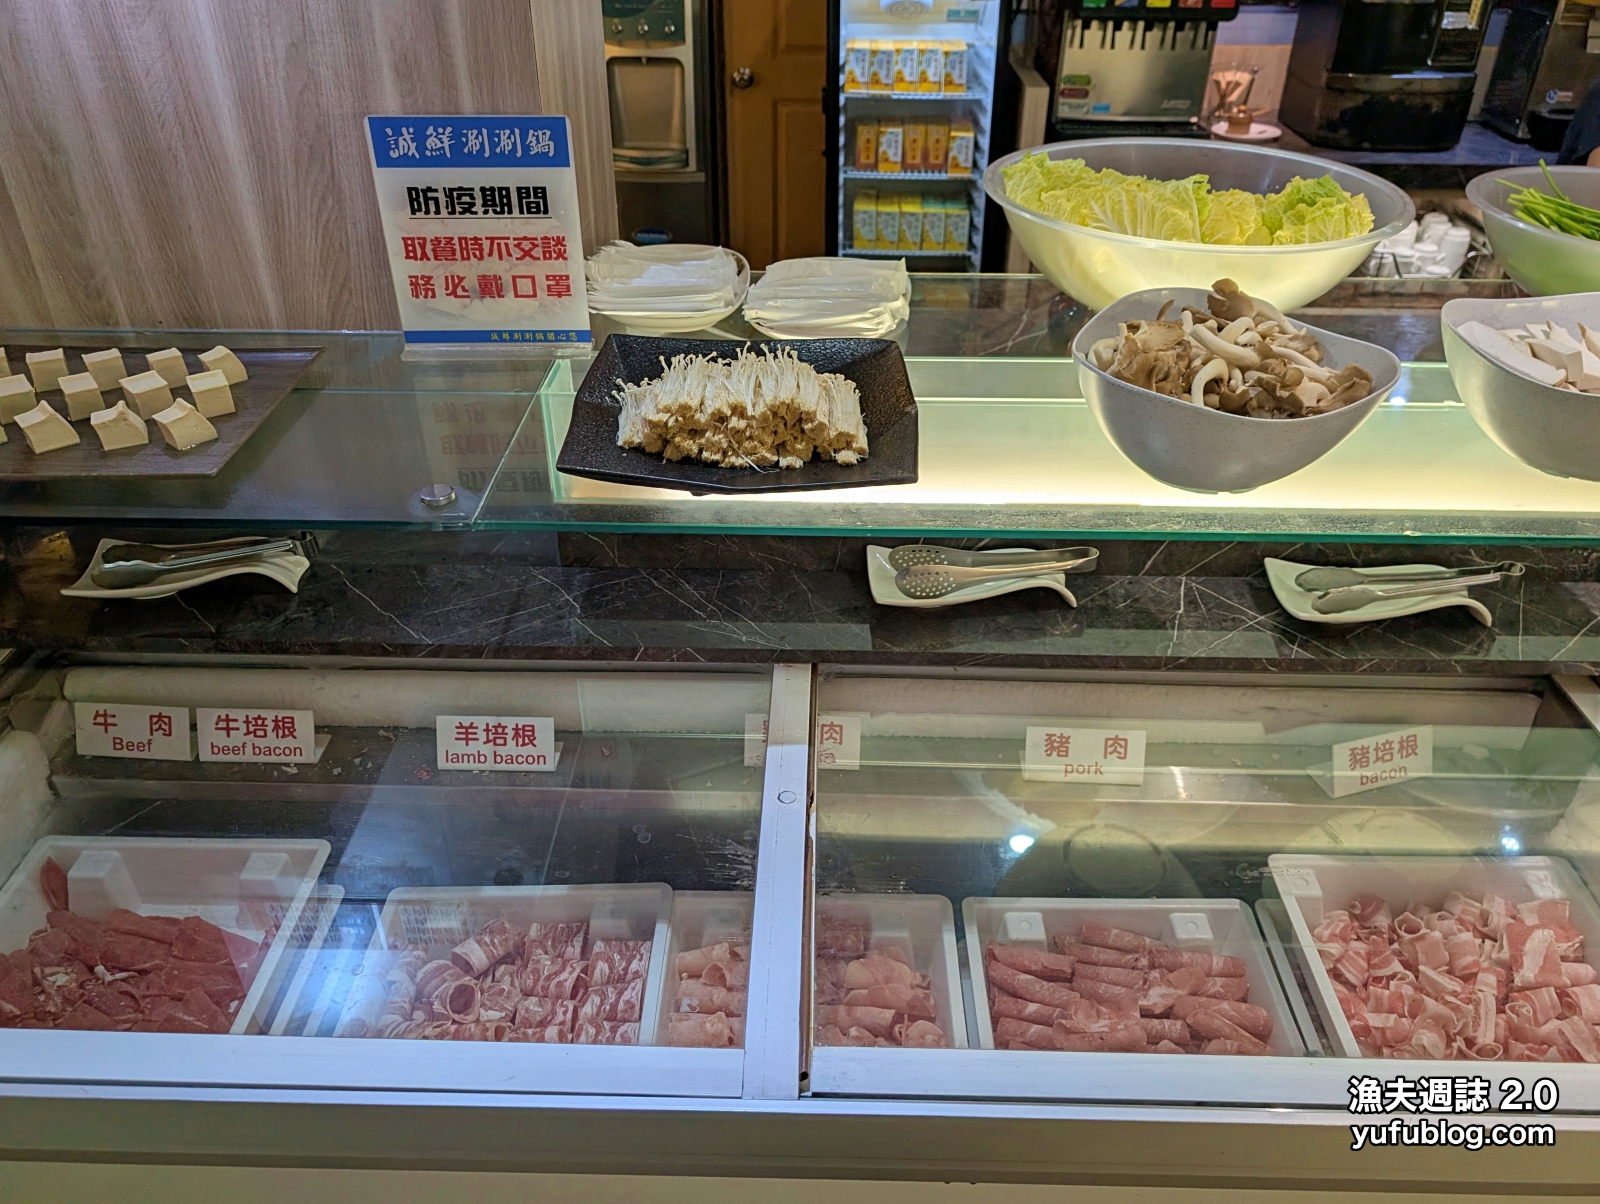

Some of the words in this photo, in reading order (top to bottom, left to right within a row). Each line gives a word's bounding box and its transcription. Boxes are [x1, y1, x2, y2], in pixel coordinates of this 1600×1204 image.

[385, 126, 555, 159] 誠鮮涮涮鍋
[406, 186, 549, 216] 防疫期間
[401, 236, 568, 262] 取餐時不交談
[408, 274, 573, 299] 務必戴口罩
[214, 713, 298, 740] 牛培根
[454, 721, 537, 748] 羊培根
[112, 736, 154, 753] Beef
[210, 742, 247, 756] beef
[252, 743, 303, 757] bacon
[445, 749, 488, 764] lamb
[493, 750, 547, 765] bacon
[1348, 733, 1419, 771] 豬培根
[1064, 761, 1104, 777] pork
[1360, 765, 1408, 786] bacon
